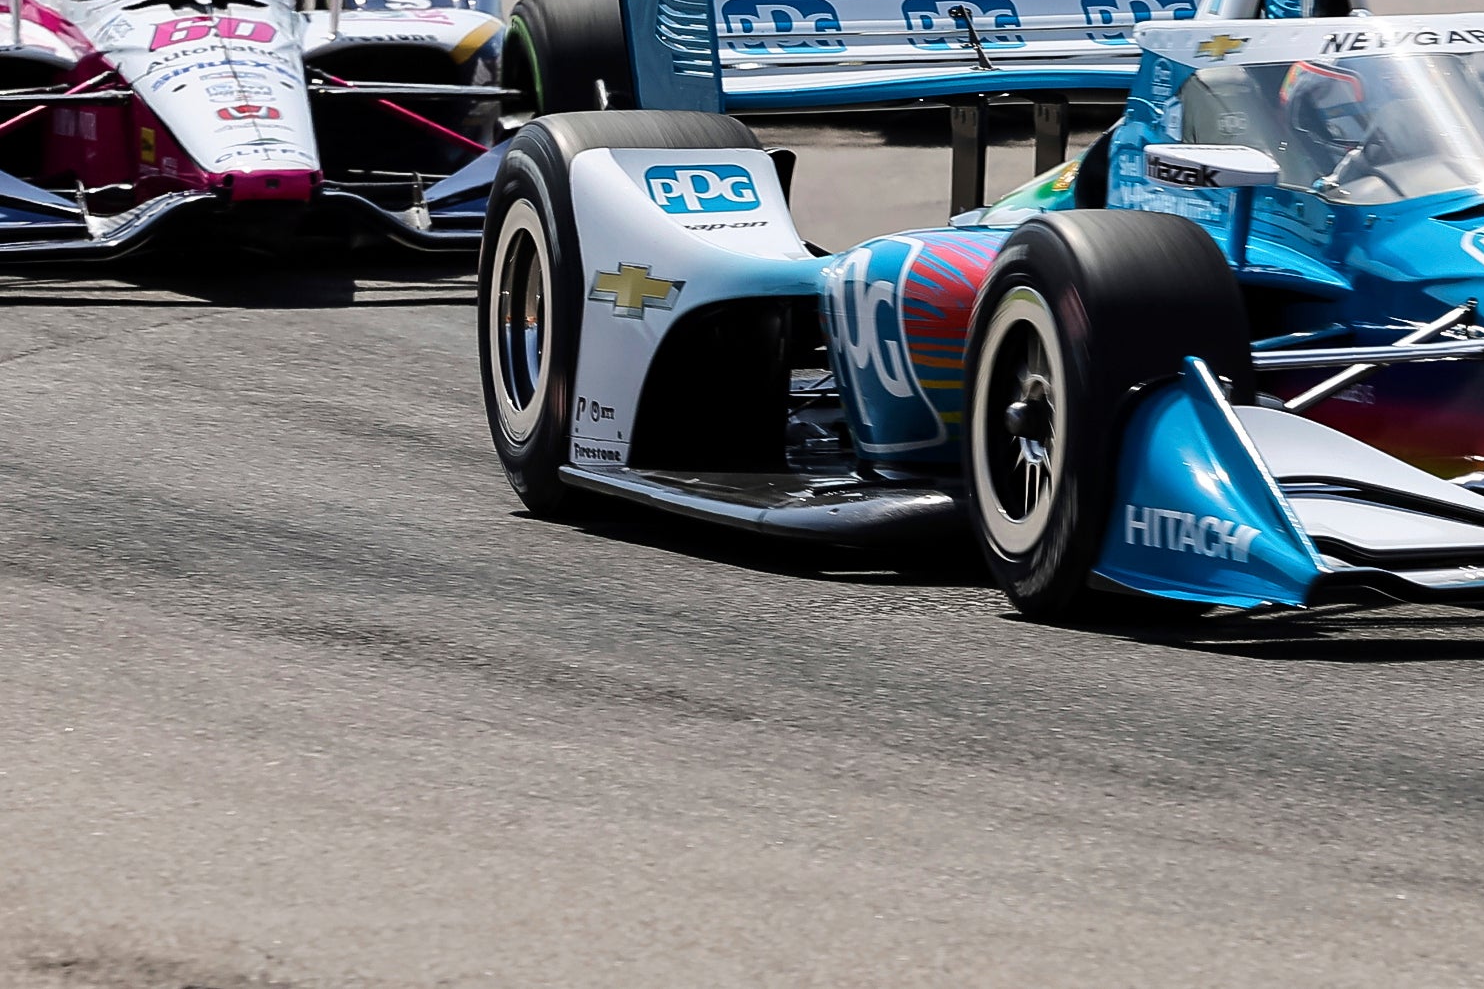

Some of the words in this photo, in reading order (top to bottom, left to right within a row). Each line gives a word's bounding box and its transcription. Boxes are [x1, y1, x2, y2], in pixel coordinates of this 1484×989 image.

[149, 15, 277, 52] 60
[649, 169, 757, 211] PPG
[573, 442, 622, 462] Firestone
